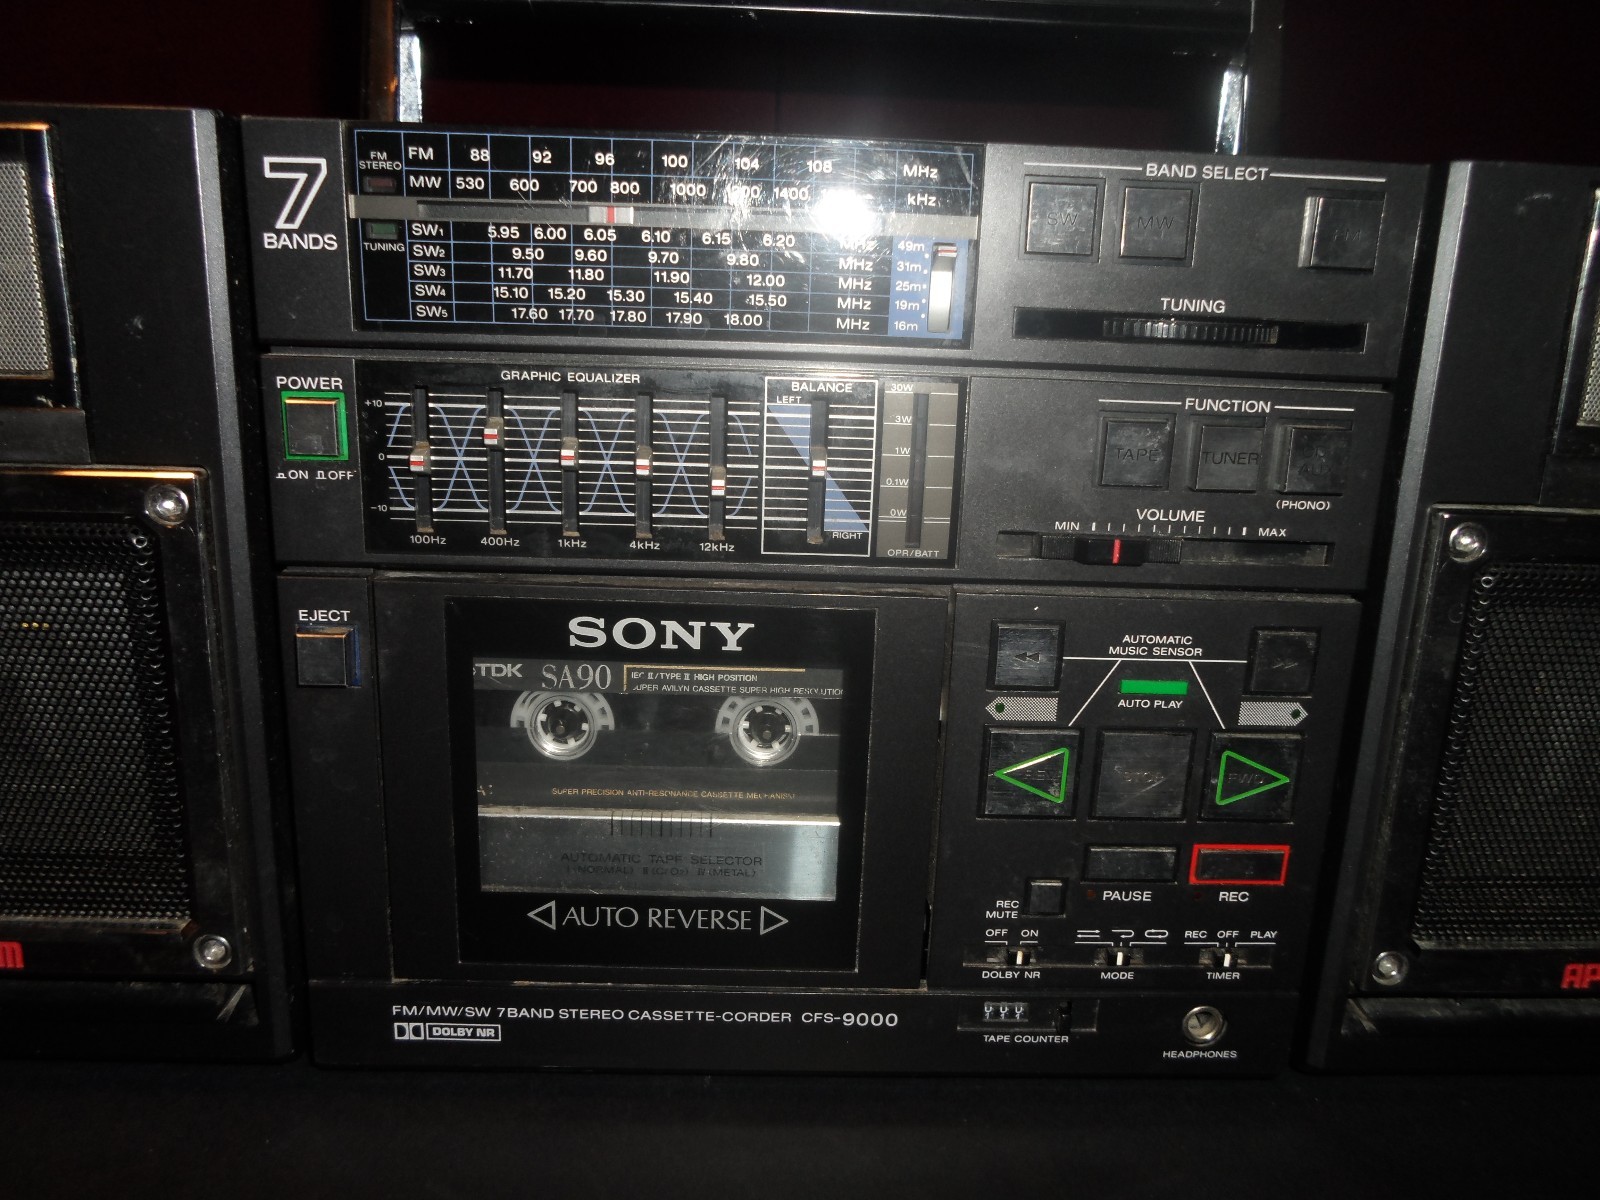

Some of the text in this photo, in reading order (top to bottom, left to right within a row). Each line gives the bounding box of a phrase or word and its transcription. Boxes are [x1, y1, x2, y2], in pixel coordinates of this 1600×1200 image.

[370, 152, 387, 160] FM
[359, 161, 402, 170] STEREO
[408, 147, 938, 178] FM 88 92 96 100 104 108 MHz
[1146, 164, 1268, 180] BAND SELECT
[264, 156, 327, 230] 7
[409, 176, 442, 189] MW
[456, 177, 484, 190] 530
[509, 179, 539, 192] 600
[569, 181, 597, 193] 700
[610, 182, 639, 194] 800
[670, 183, 706, 197] 1000
[773, 188, 809, 200] 1400
[907, 193, 936, 207] kHz
[1048, 213, 1078, 226] SW
[1137, 216, 1174, 230] MW
[412, 224, 444, 237] SW1
[488, 226, 520, 239] 5.95
[534, 228, 567, 240] 6.00
[583, 229, 617, 241] 6.05
[641, 230, 671, 243] 6.10
[702, 232, 731, 245] 6.15
[762, 234, 795, 247] 6.20
[263, 233, 338, 250] BANDS
[898, 241, 924, 251] 49m
[363, 243, 405, 252] TUNING
[412, 245, 873, 271] SW2 9.50 9.60 9.70 9.80 MHz
[897, 262, 922, 272] 31m
[413, 265, 872, 291] SW3 11.70 11.80 11.90 12.00 MHz
[895, 281, 921, 291] 25m
[415, 285, 871, 310] SW4 15.10 15.20 15.30 15.40 15.50 MHz
[894, 300, 920, 311] 19m
[1161, 298, 1225, 313] TUNING
[415, 305, 870, 330] SW5 17.60 17.70 17.80 17.90 18.00 MHz
[893, 321, 918, 331] 16m
[276, 376, 343, 390] POWER
[501, 371, 640, 384] GRAPHIC EQUALIZER
[792, 382, 852, 393] BALANCE
[891, 384, 913, 392] 30W
[365, 399, 382, 407] +10
[777, 396, 801, 404] LEFT
[1185, 398, 1271, 413] FUNCTION
[895, 415, 911, 423] 3W
[895, 447, 910, 455] 1W
[1116, 448, 1160, 462] TAPE
[378, 453, 384, 461] 0
[1203, 451, 1259, 465] TUNER
[289, 470, 353, 480] ON OFF
[886, 478, 909, 486] 0.1W
[1276, 500, 1331, 511] (PHONO)
[890, 509, 907, 517] 0W
[1136, 508, 1205, 523] VOLUME
[1054, 522, 1287, 537] MIN MAX
[832, 531, 862, 540] RIGHT
[410, 535, 735, 552] 100Hz 400Hz 1kHz 4kHz 12kHz
[887, 550, 939, 558] OPR/BATT
[299, 609, 350, 621] EJECT
[568, 616, 755, 652] SONY
[1122, 634, 1192, 645] AUTOMATIC
[1108, 646, 1202, 656] MUSIC SENSOR
[475, 664, 522, 677] TDK
[542, 664, 612, 690] SA90
[1118, 699, 1183, 709] AUTO PLAY
[561, 853, 641, 863] AUTOMATIC
[691, 856, 762, 866] SELECTOR
[1103, 890, 1152, 902] PAUSE
[1219, 891, 1249, 902] REC
[996, 900, 1019, 908] REC
[562, 907, 751, 931] AUTO REVERSE
[986, 911, 1018, 919] MUTE
[985, 929, 1039, 937] OFF ON
[1185, 930, 1277, 939] REC OFF PLAY
[982, 971, 1040, 979] DOLBY NR
[1101, 972, 1134, 980] MODE
[1207, 972, 1240, 980] TIMER
[392, 1006, 491, 1018] FM/MW/SW
[559, 1009, 624, 1020] STEREO
[628, 1010, 792, 1023] CASSETTE-CORDER
[801, 1012, 898, 1027] CFS-9000
[433, 1027, 495, 1037] DOLBY NR
[1163, 1050, 1237, 1059] HEADPHONES
